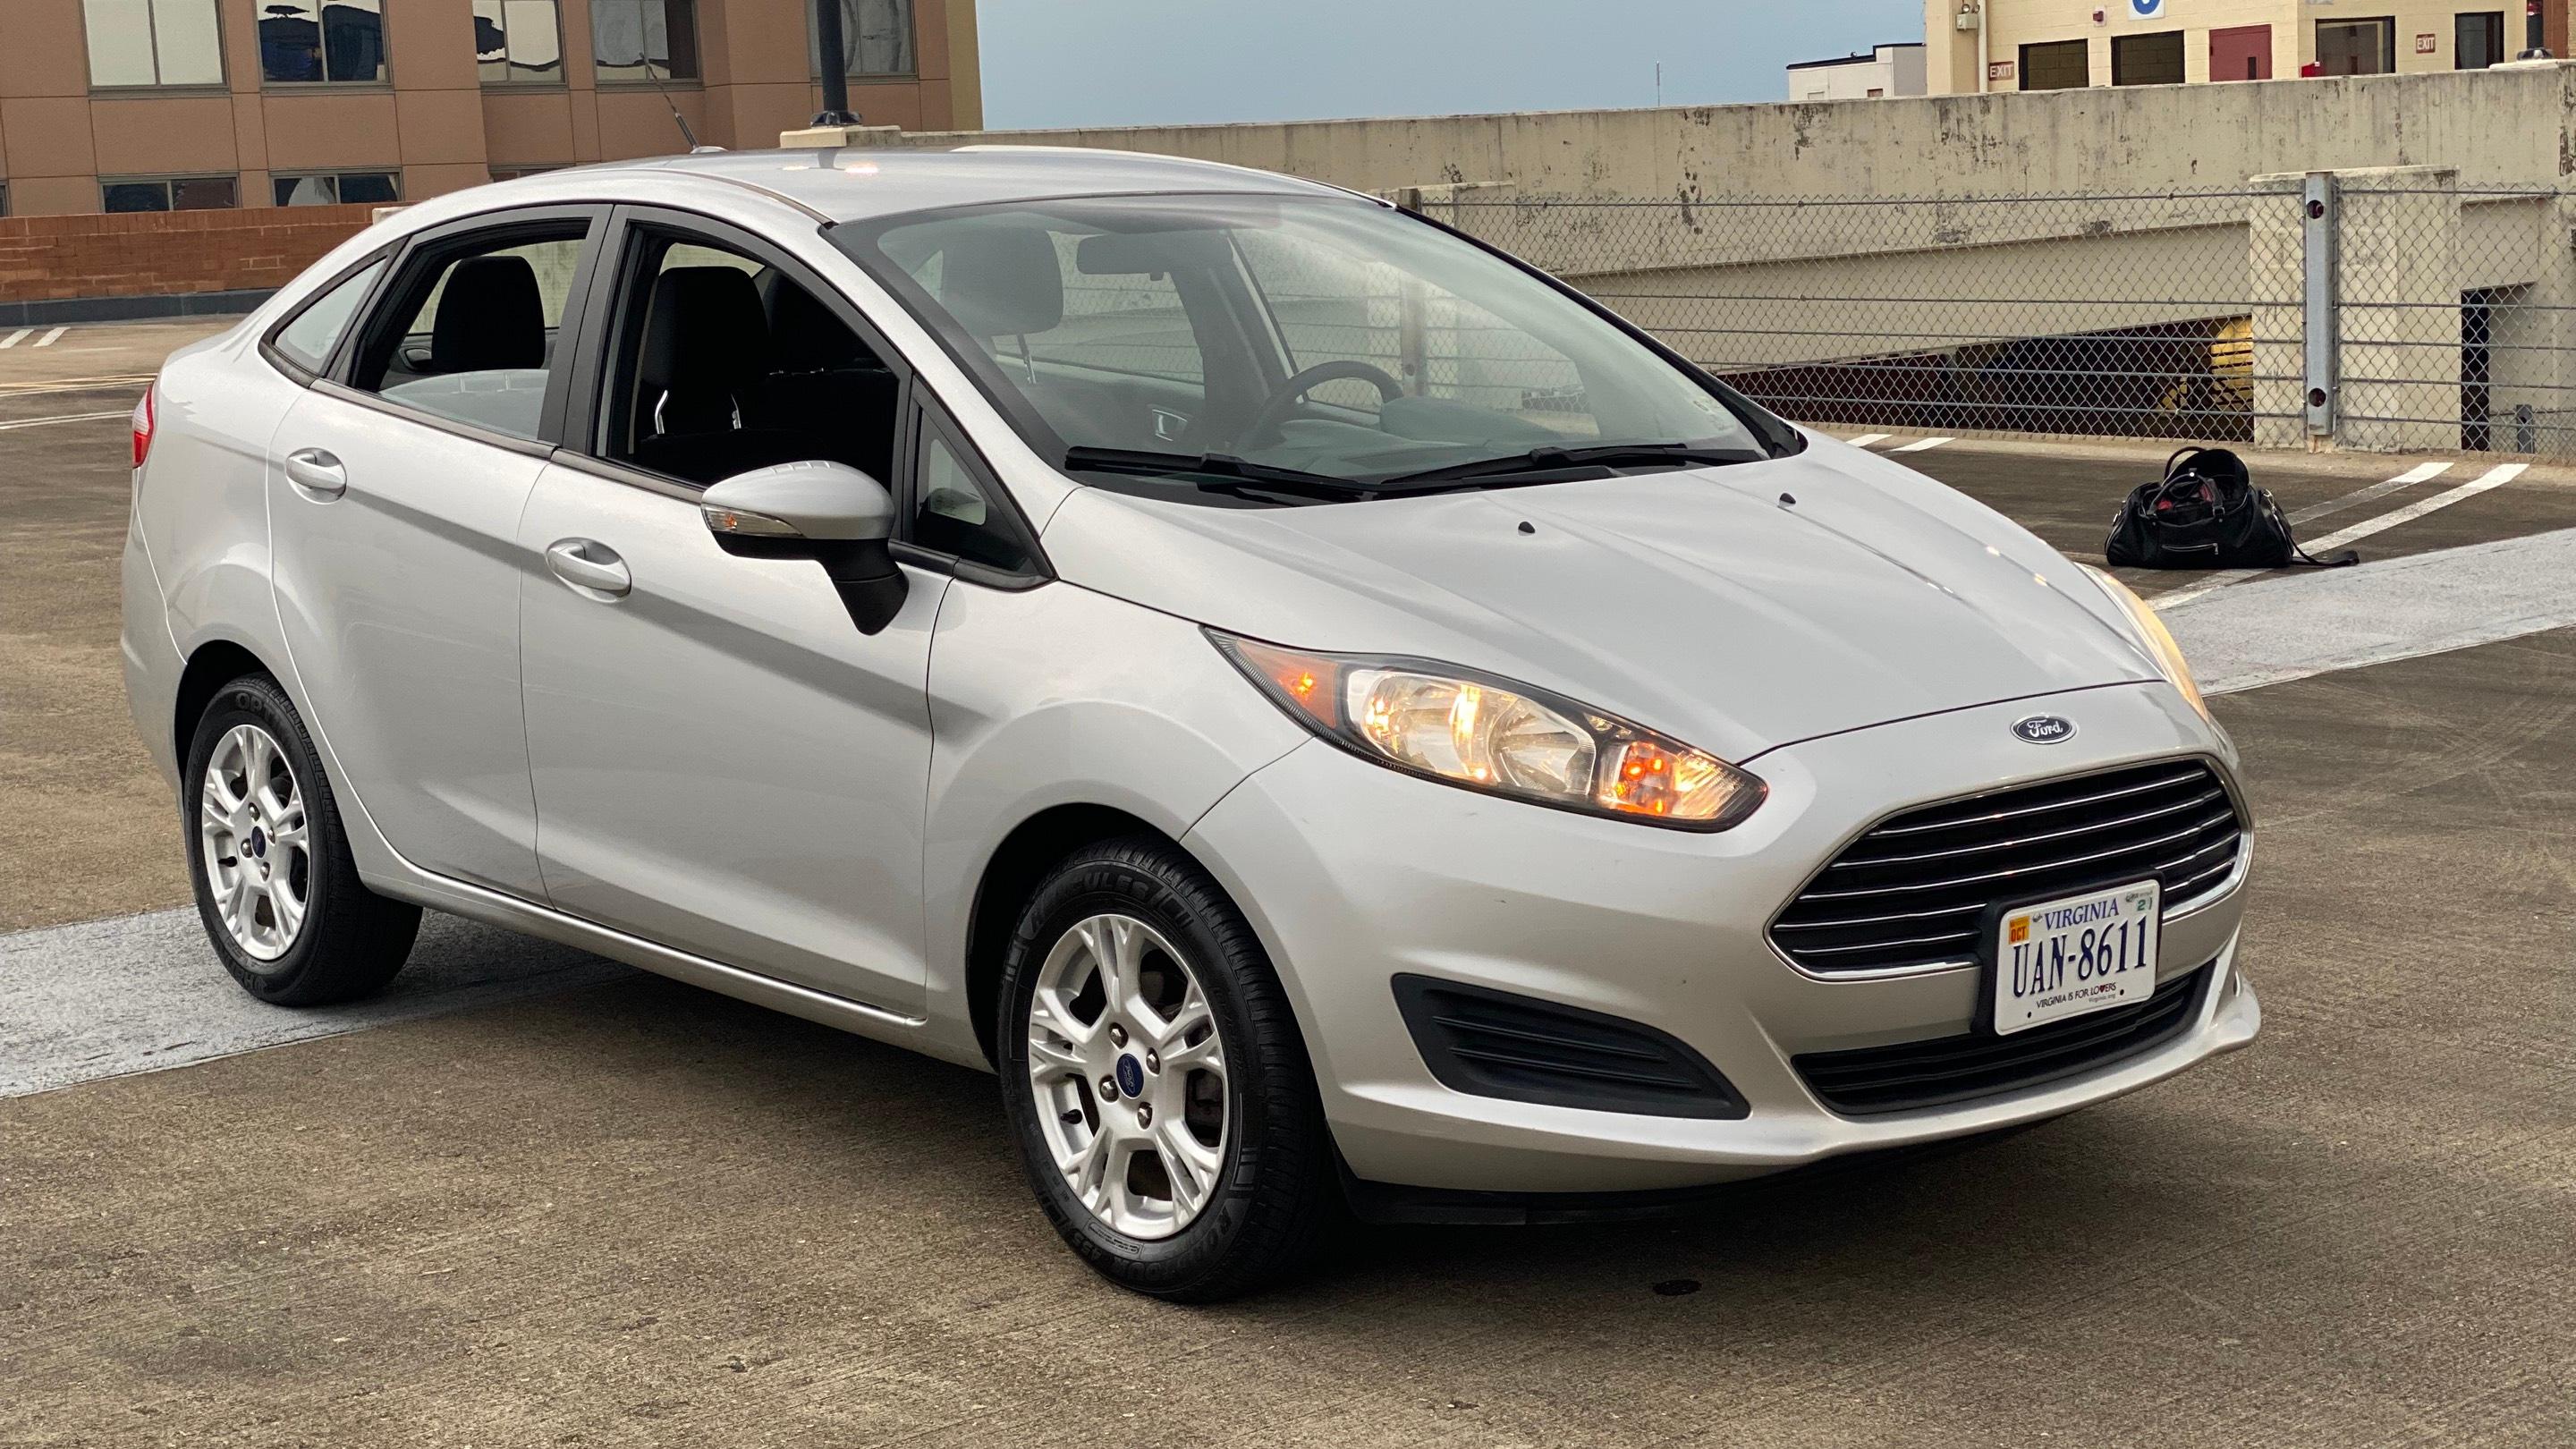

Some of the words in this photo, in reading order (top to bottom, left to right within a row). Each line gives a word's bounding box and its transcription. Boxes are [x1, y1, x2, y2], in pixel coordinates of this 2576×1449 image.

[2417, 37, 2435, 50] EXIT
[1989, 64, 2013, 78] EXIT
[2026, 718, 2063, 738] Ford
[2136, 896, 2153, 911] 21
[2045, 898, 2120, 931] VIRGINIA
[2011, 925, 2027, 943] OCT
[2012, 914, 2147, 998] UAN-8611
[2036, 994, 2066, 1009] VIRGINIA
[2068, 991, 2074, 1002] IS
[2075, 987, 2089, 1000] FOR
